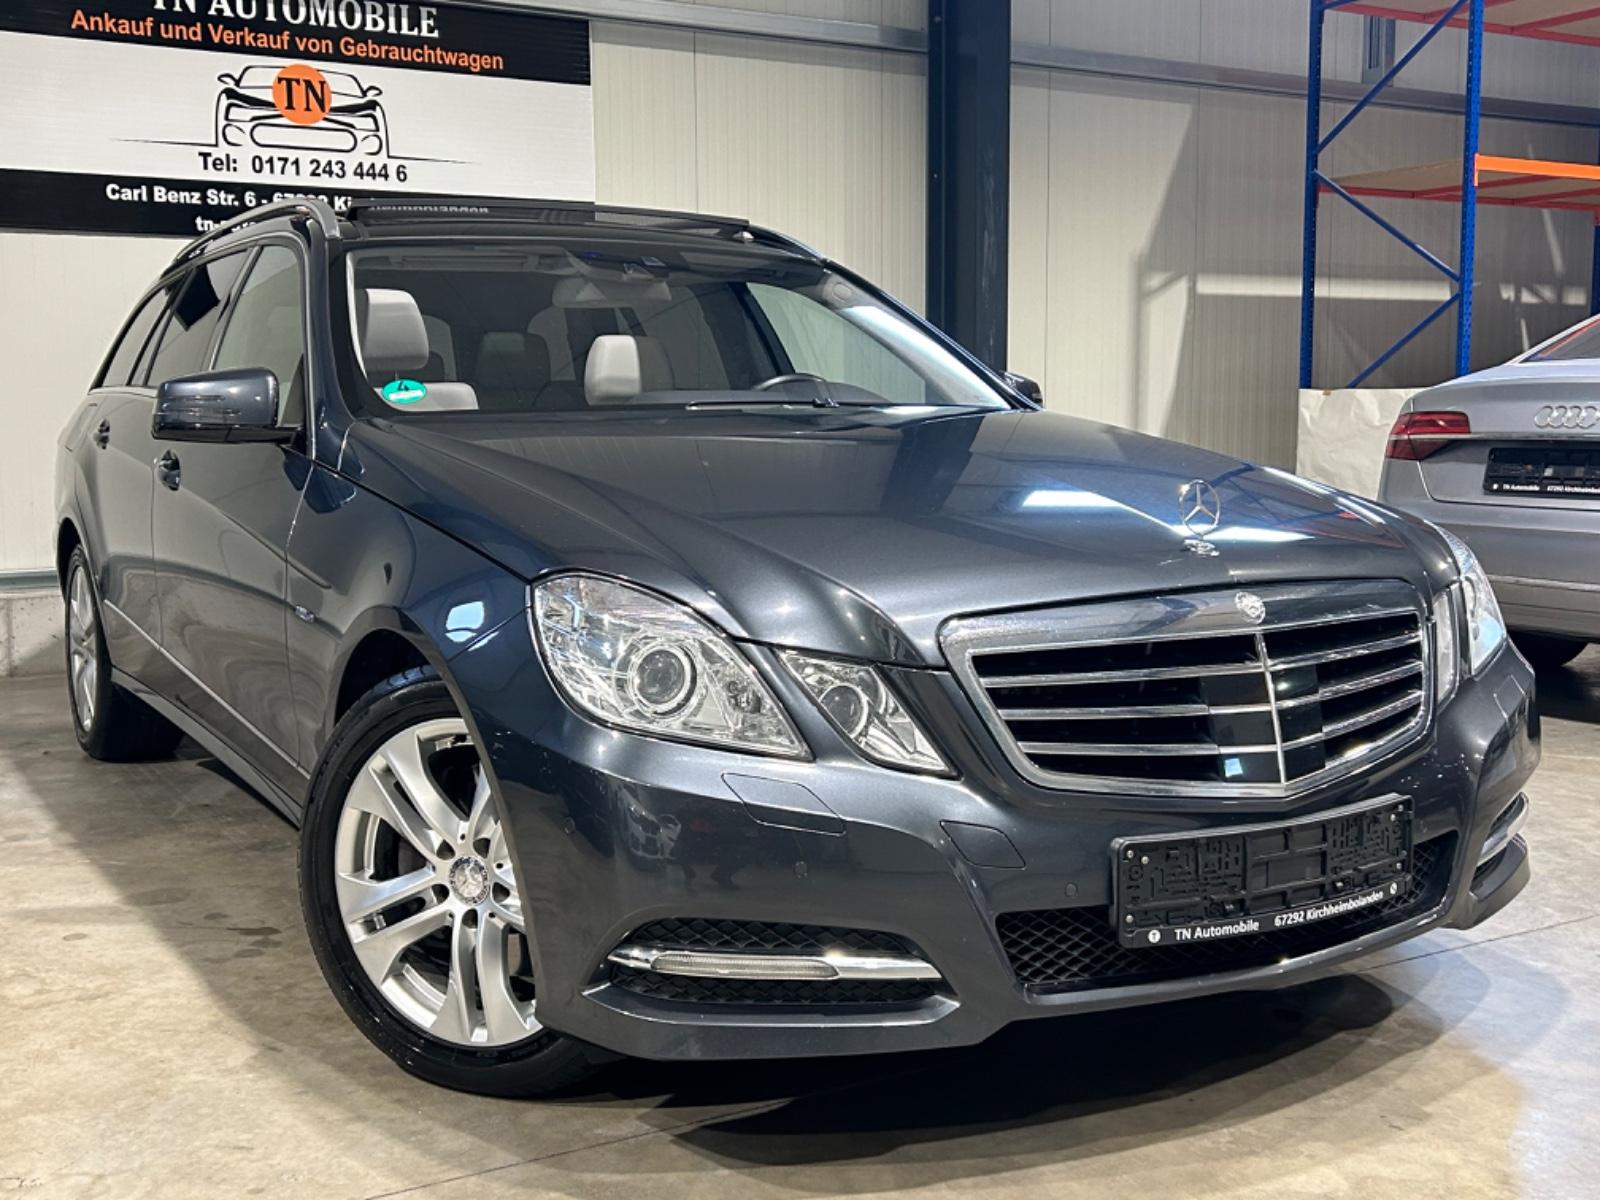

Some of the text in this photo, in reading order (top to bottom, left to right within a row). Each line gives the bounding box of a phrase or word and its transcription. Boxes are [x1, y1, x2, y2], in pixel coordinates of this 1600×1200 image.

[208, 0, 439, 38] AUTOMOBILE
[71, 9, 503, 72] Ankauf und Verkauf von Gebrauchtwagen
[277, 77, 326, 113] TN
[198, 152, 408, 182] Tel: 0171 243 444 6
[105, 183, 147, 202] Carl
[153, 186, 201, 205] Benz
[206, 188, 239, 206] Str.
[244, 191, 256, 207] 6
[1174, 928, 1192, 941] TN
[1193, 919, 1259, 939] Automobile
[1274, 911, 1305, 927] 67292
